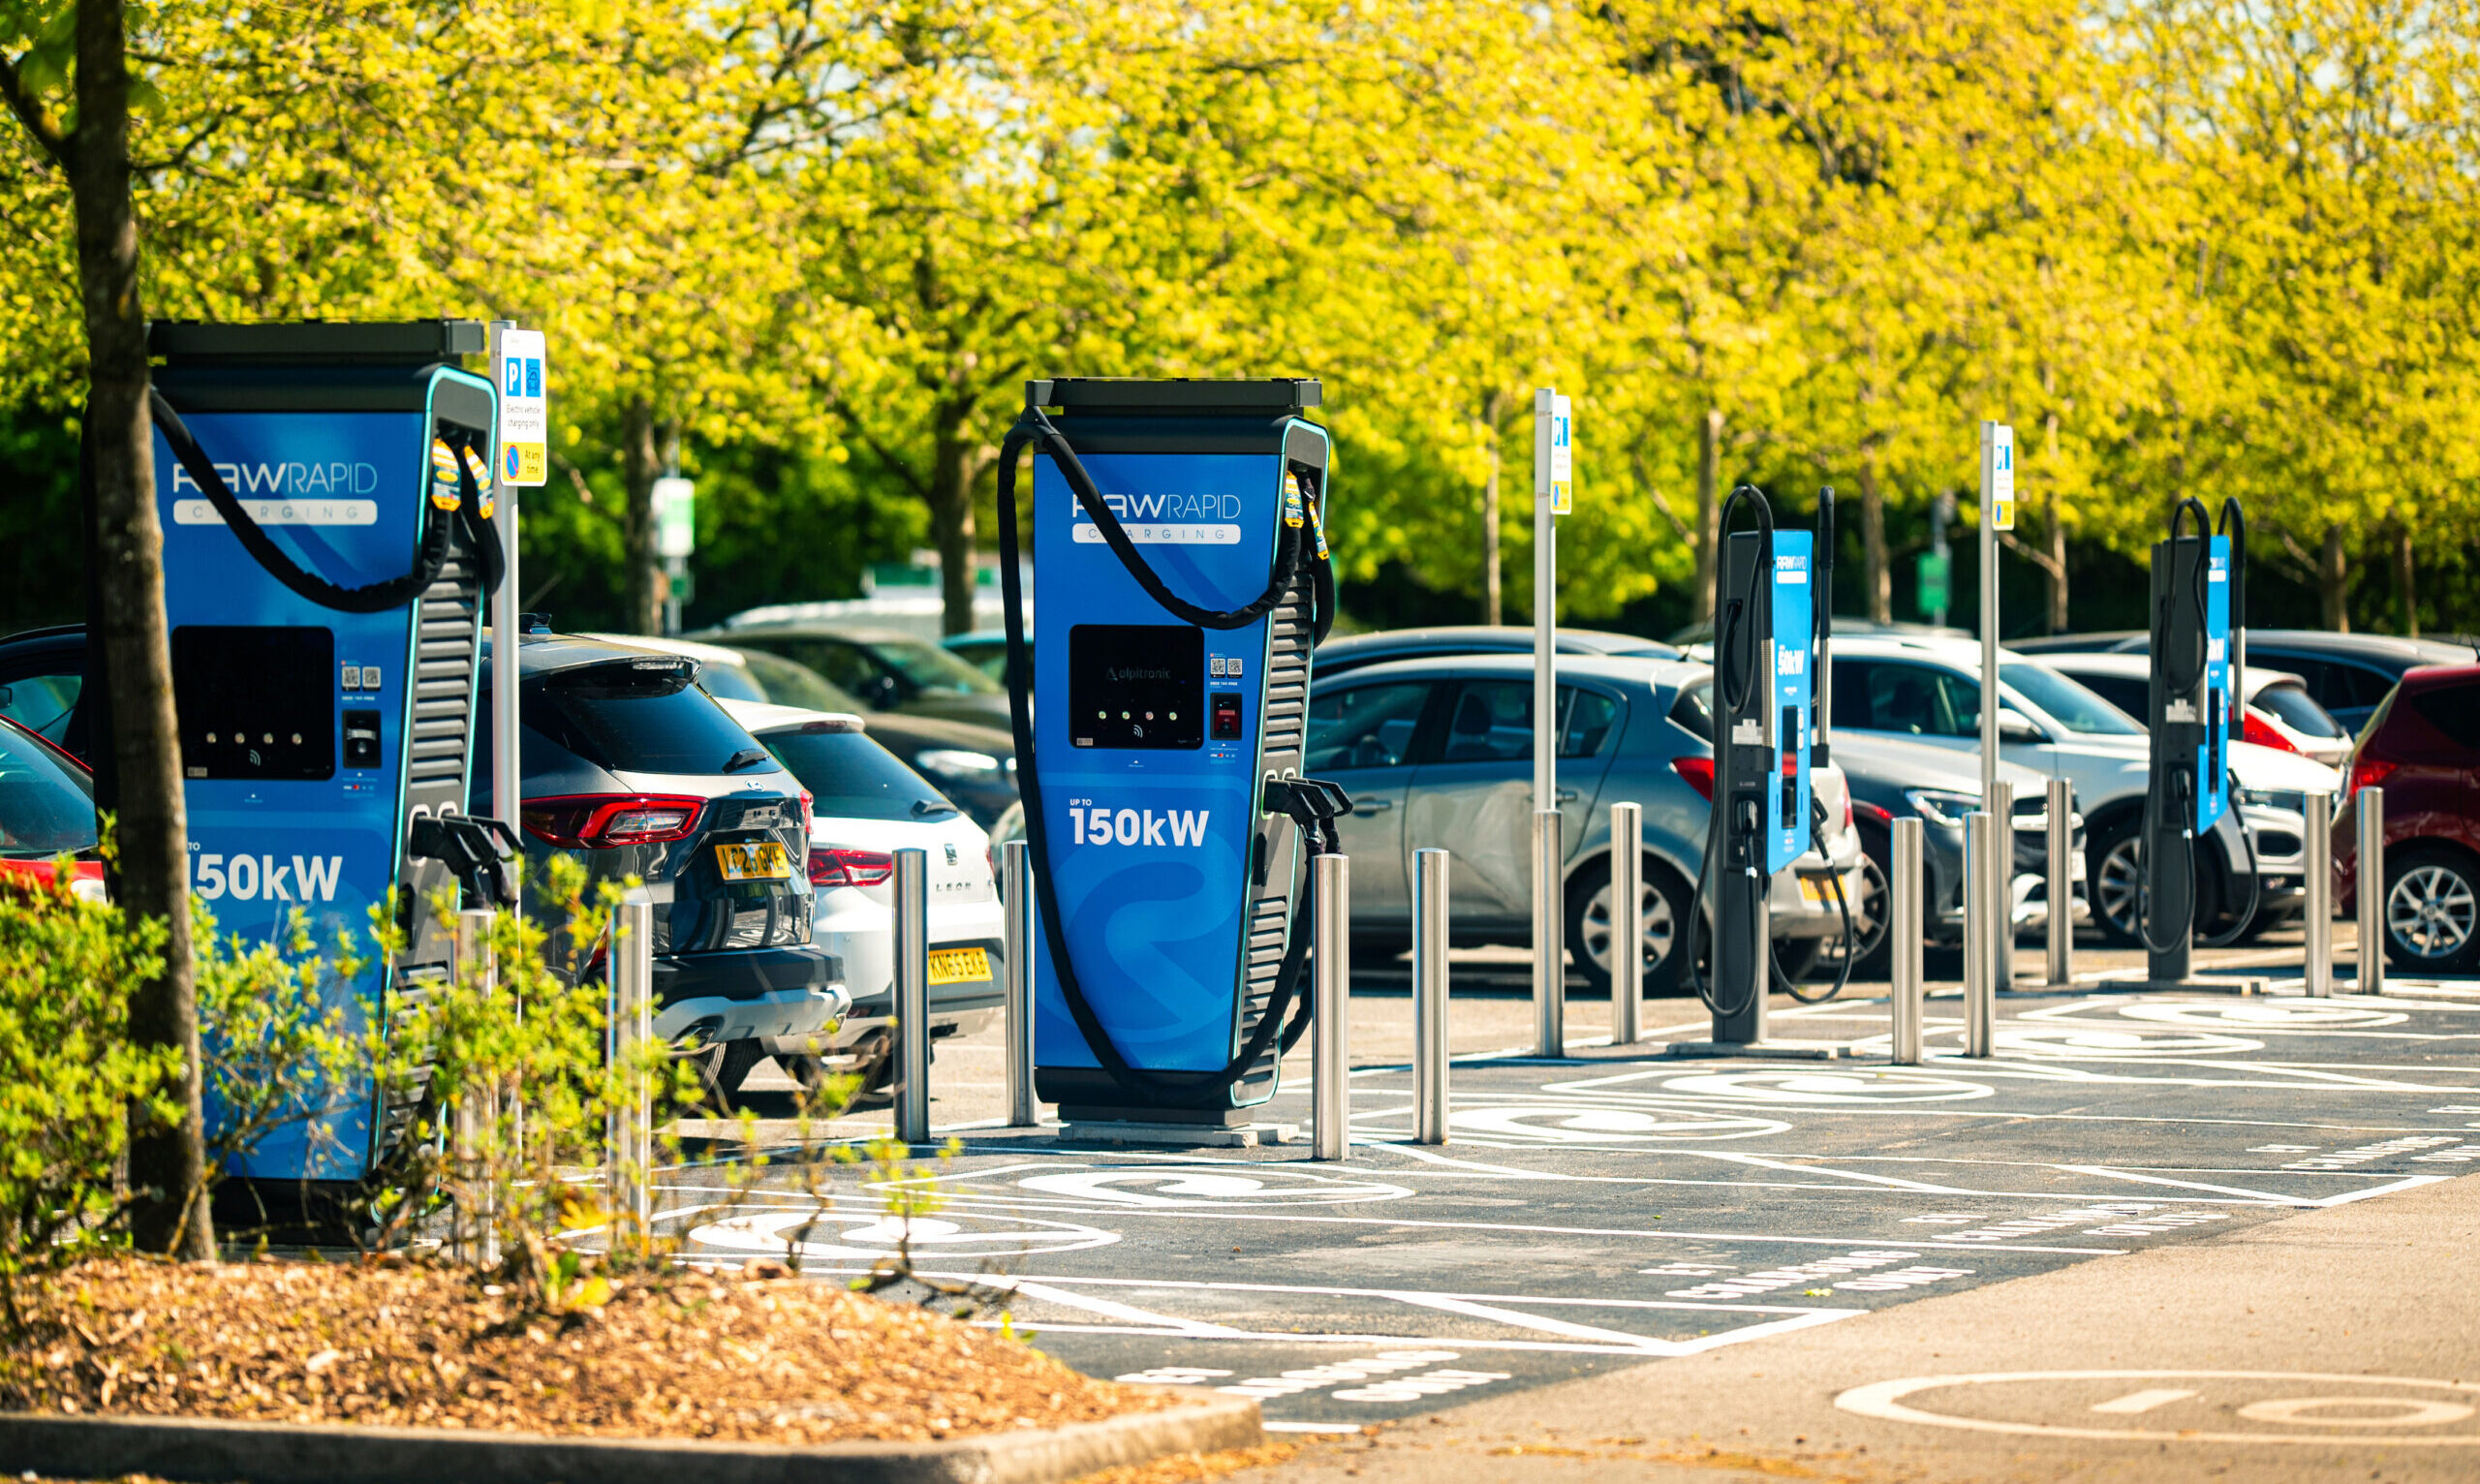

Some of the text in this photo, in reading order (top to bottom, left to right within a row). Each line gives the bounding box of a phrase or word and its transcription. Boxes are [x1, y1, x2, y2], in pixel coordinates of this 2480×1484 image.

[506, 404, 541, 415] Electric vehicle
[508, 418, 528, 430] charging
[192, 506, 358, 519] CRGING
[1088, 528, 1224, 540] CARGING
[1778, 649, 1805, 675] 50kW
[1082, 798, 1093, 807] TO
[1070, 808, 1210, 847] 150kW
